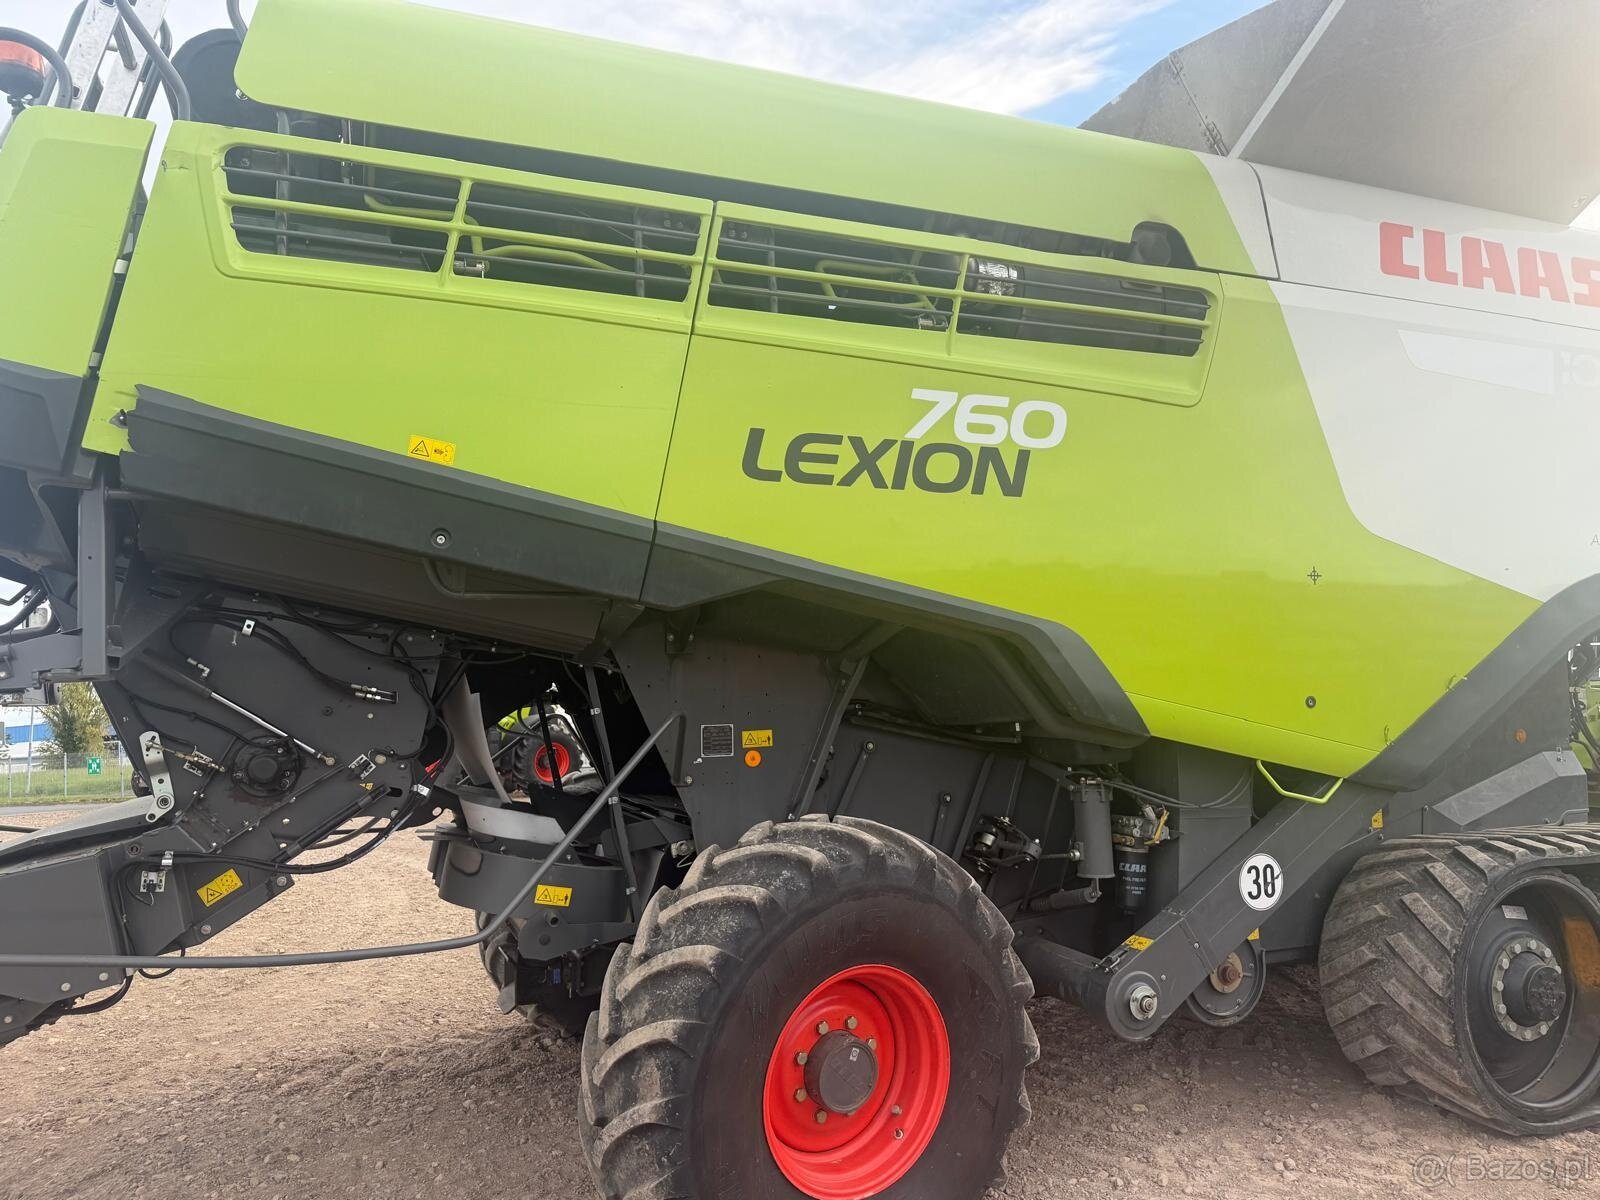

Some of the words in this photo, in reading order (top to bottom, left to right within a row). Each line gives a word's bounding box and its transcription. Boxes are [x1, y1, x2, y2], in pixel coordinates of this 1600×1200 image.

[1379, 221, 1600, 309] CLAAS
[904, 388, 1067, 449] 760
[742, 427, 1031, 498] LEXION
[1119, 863, 1147, 873] CLAA
[1247, 864, 1276, 900] 30
